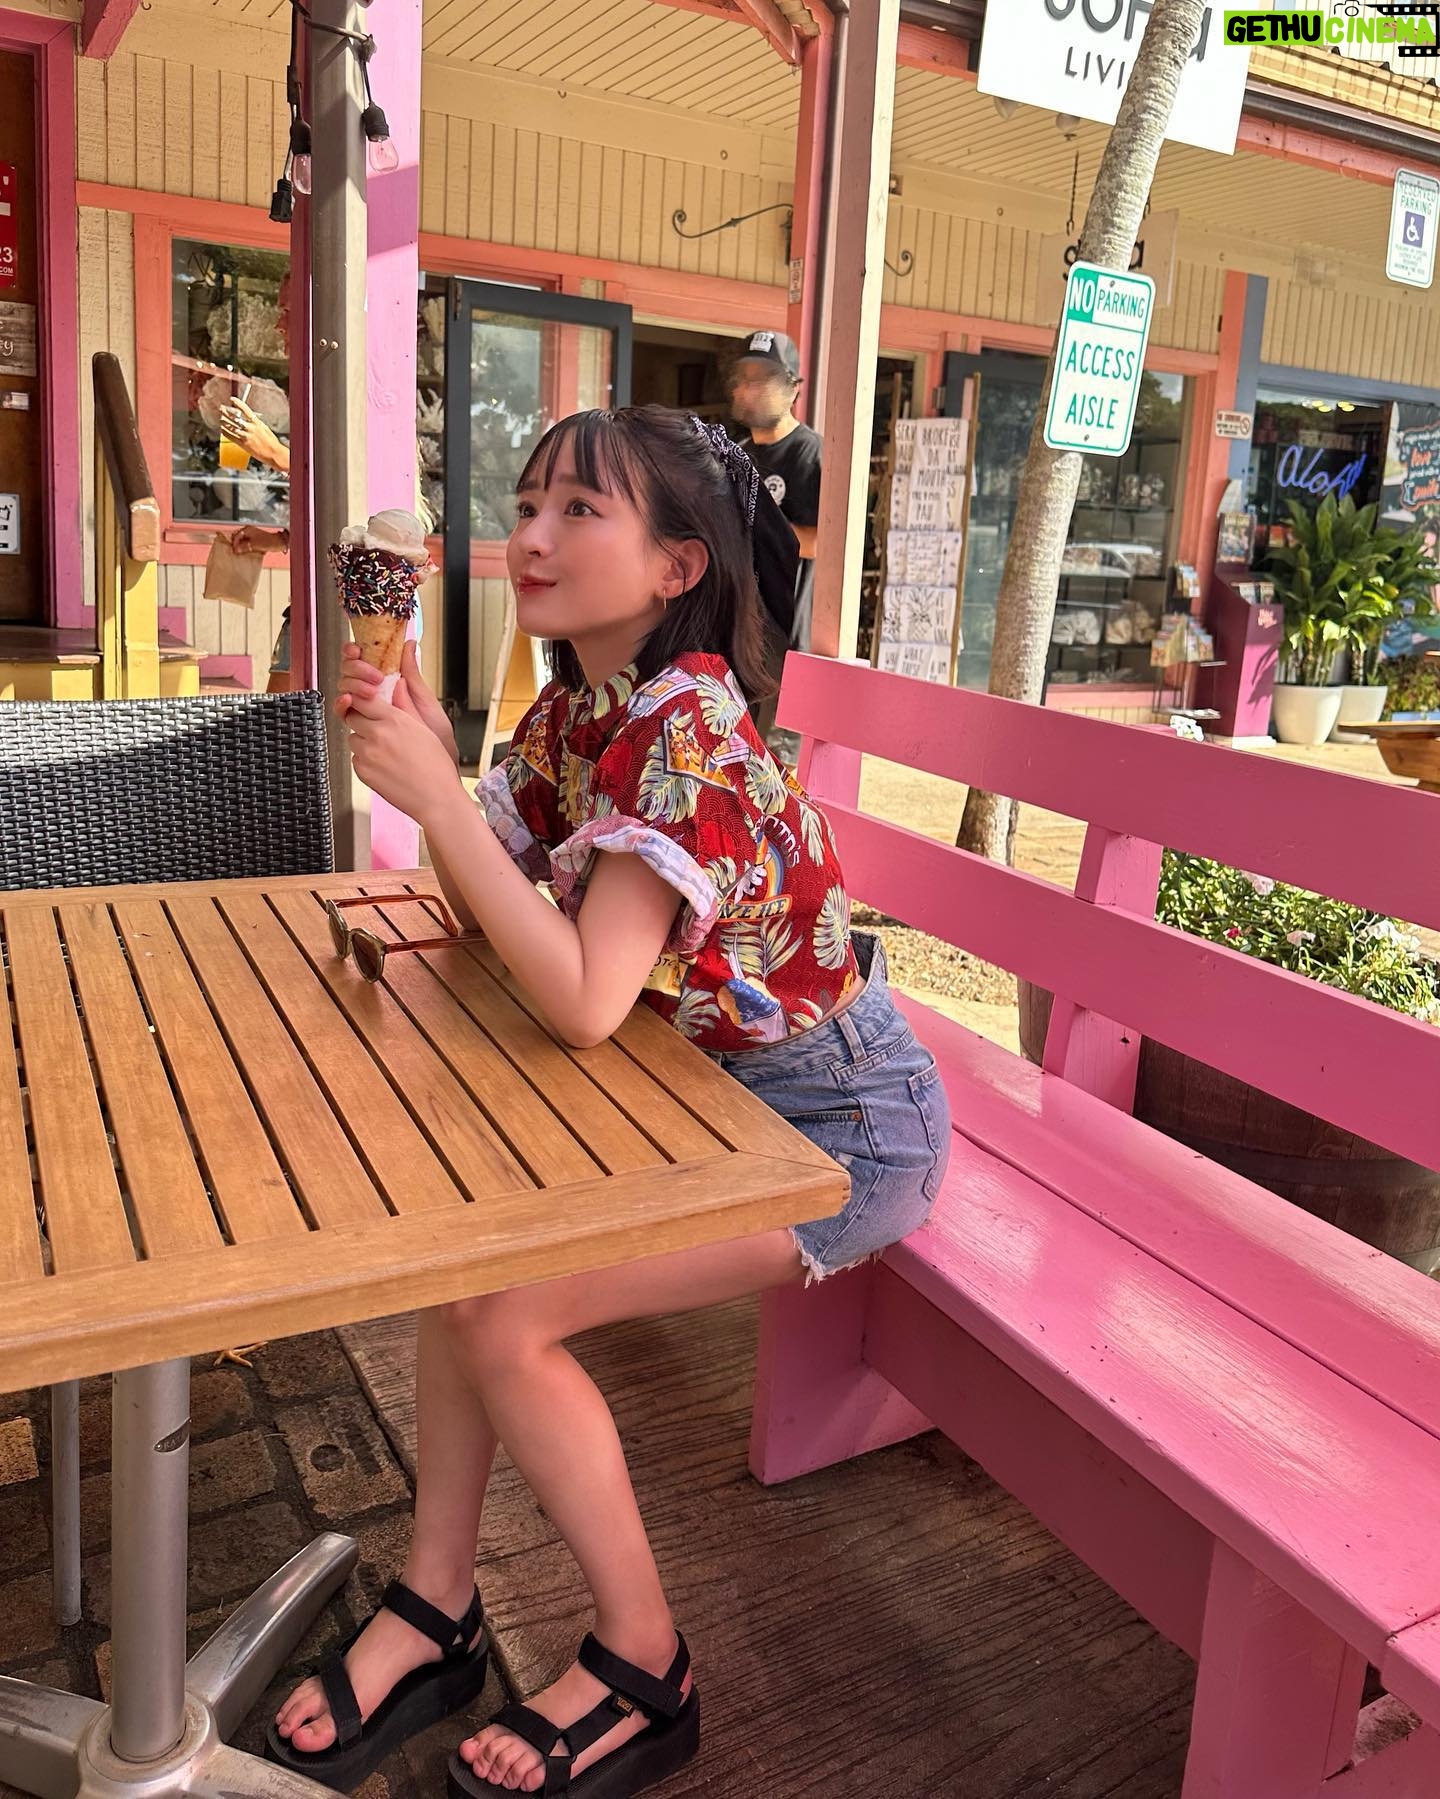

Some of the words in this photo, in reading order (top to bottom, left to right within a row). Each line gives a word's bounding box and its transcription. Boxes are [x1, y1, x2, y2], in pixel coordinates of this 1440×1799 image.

[1065, 46, 1126, 90] LIVI
[1400, 195, 1432, 216] PARKING
[1069, 276, 1096, 314] NO
[1096, 288, 1146, 319] PARKING
[1064, 340, 1135, 381] ACCESS
[1064, 392, 1119, 429] AISLE
